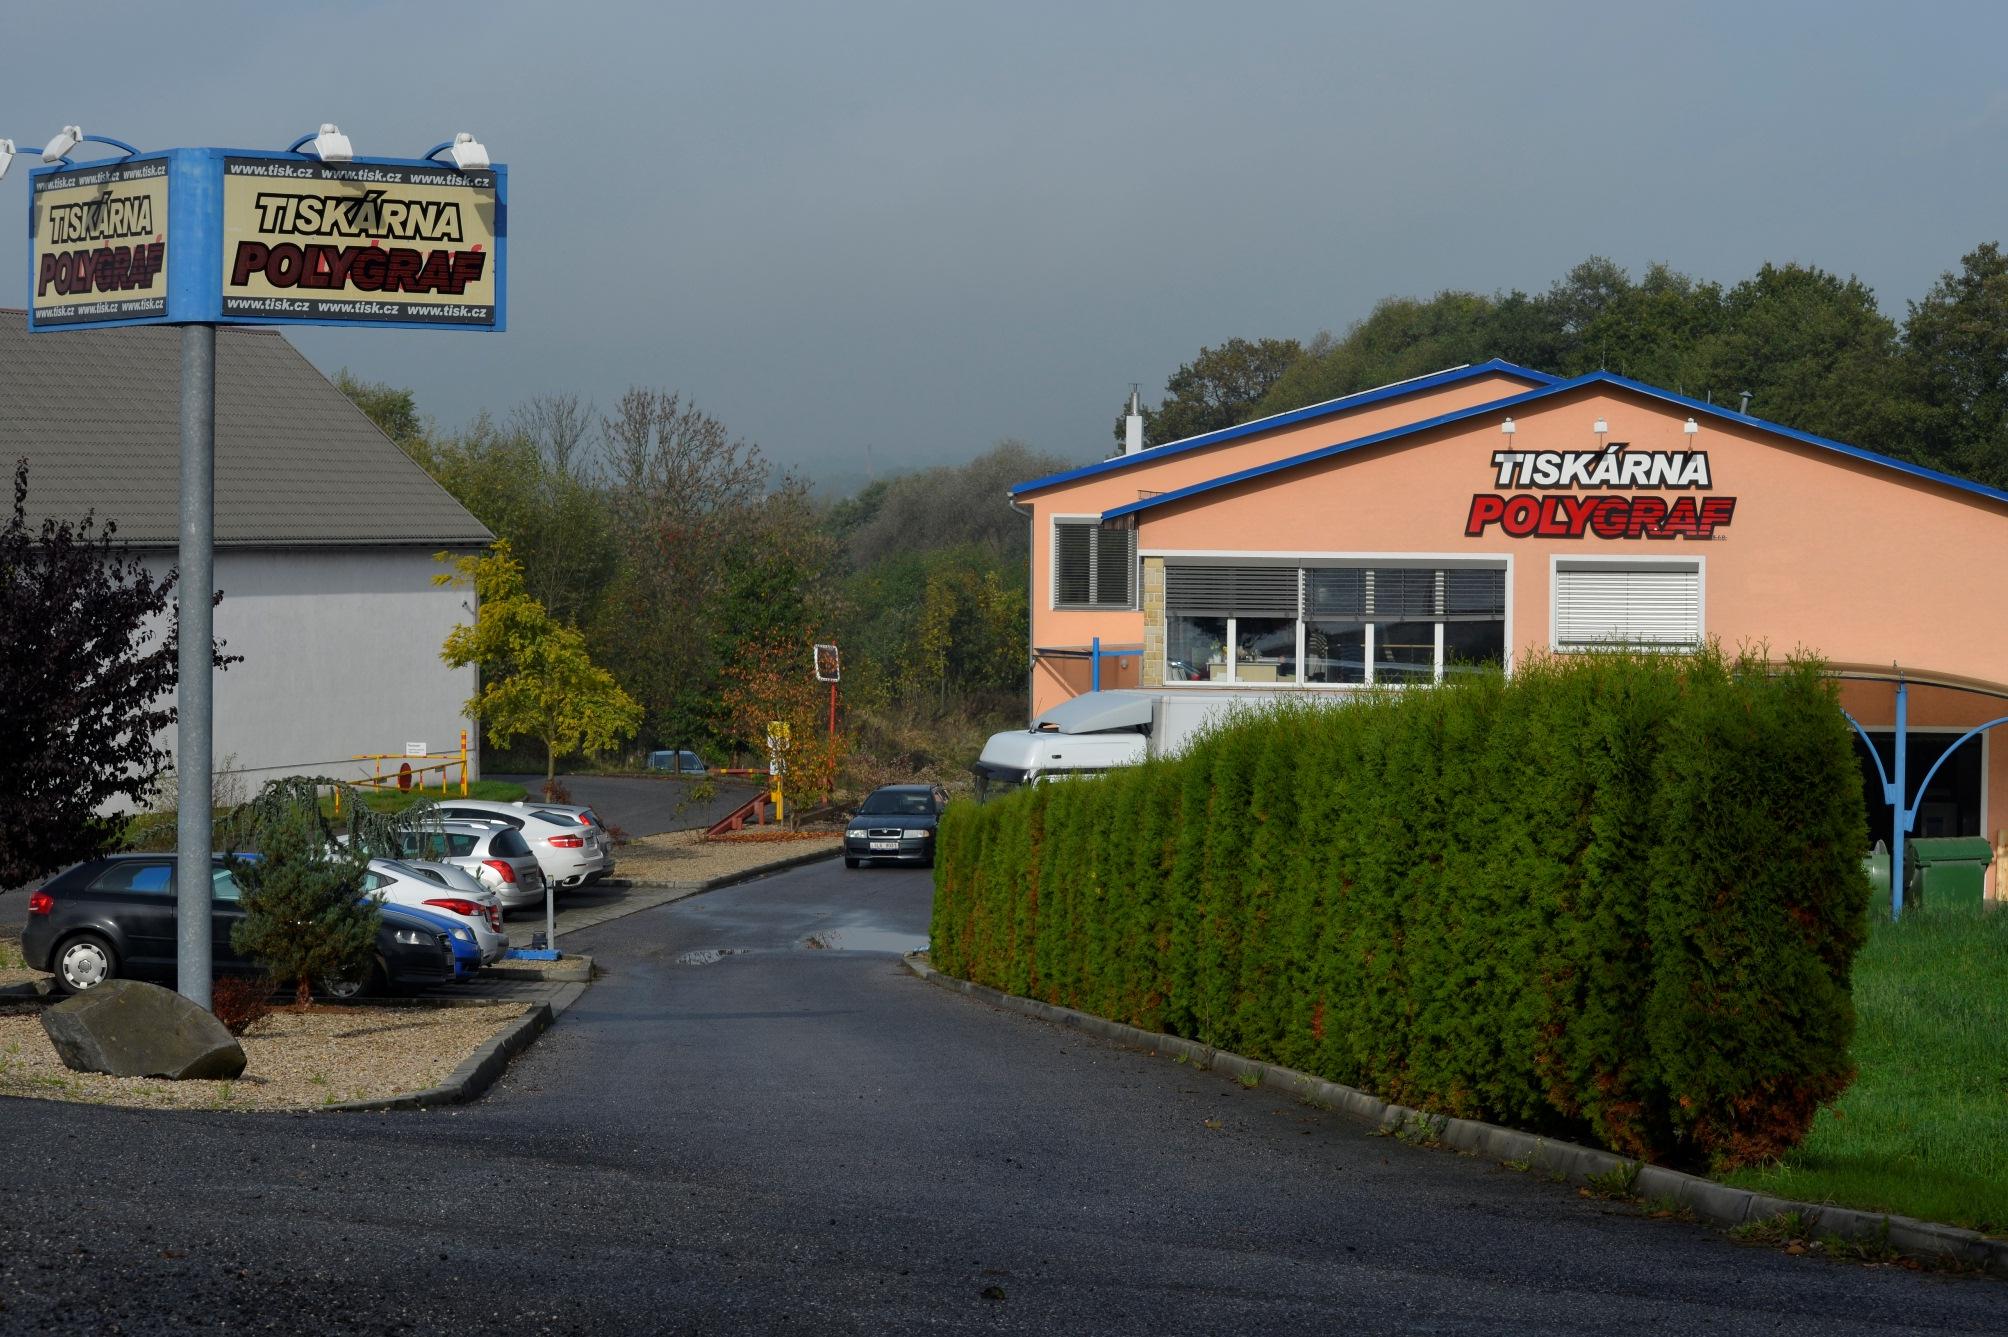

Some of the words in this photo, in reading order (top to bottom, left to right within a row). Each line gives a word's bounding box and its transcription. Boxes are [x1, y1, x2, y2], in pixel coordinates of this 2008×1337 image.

[79, 171, 120, 185] www.tisk.cz
[123, 164, 166, 179] www.tisk.cz
[230, 164, 313, 178] www.tisk.cz
[321, 169, 402, 182] www.tisk.cz
[410, 174, 490, 187] www.tisk.cz
[50, 191, 153, 244] TISKÁRNA
[255, 190, 464, 242] TISKÁRNA
[38, 242, 165, 297] POLYGRAF
[230, 241, 486, 295] POLYGRAF
[35, 305, 75, 319] www.tisk.cz
[78, 301, 119, 315] www.tisk.cz
[122, 298, 164, 311] www.tisk.cz
[227, 298, 310, 311] www.tisk.cz
[318, 301, 399, 314] www.tisk.cz
[407, 305, 487, 317] www.tisk.cz
[1490, 442, 1713, 490] TISKÁRNA
[1464, 494, 1737, 540] POLYGRAF
